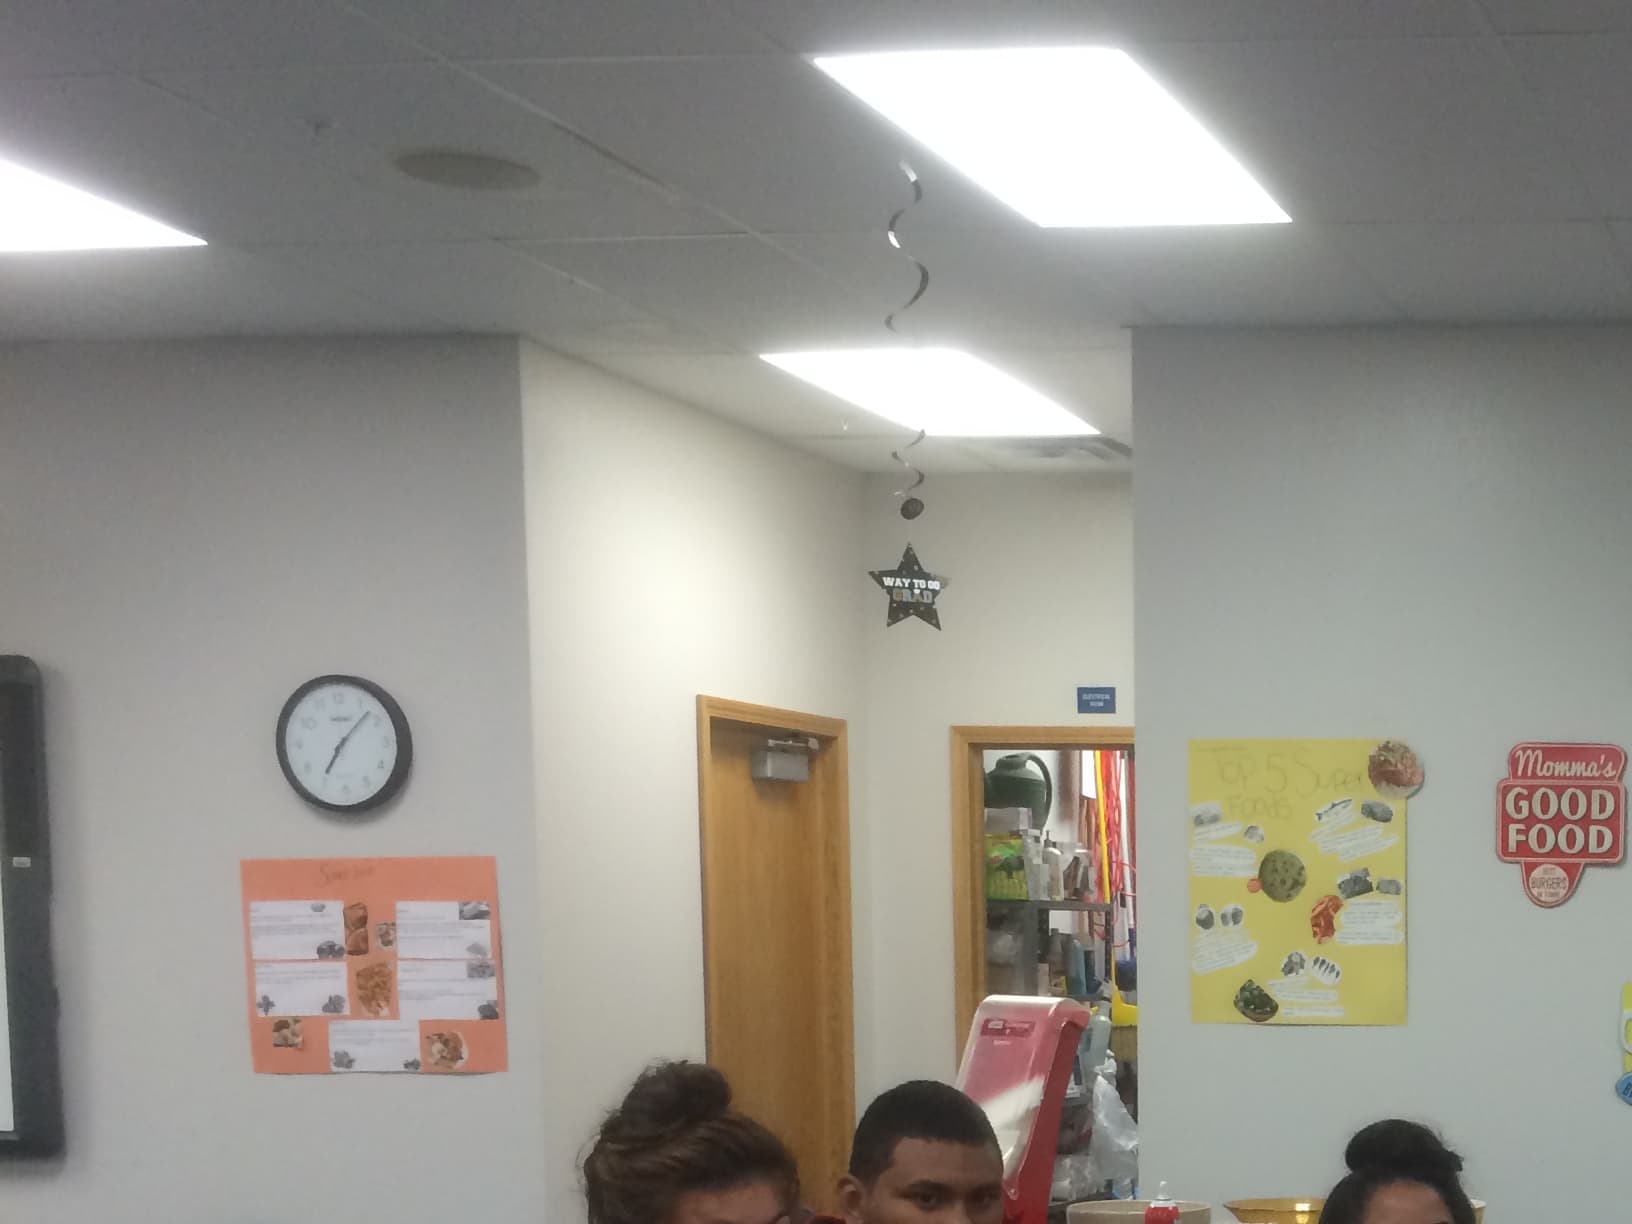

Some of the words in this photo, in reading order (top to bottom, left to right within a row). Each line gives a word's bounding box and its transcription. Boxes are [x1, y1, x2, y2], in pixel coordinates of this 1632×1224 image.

[882, 577, 911, 588] WAY
[912, 578, 926, 589] TO
[1515, 749, 1617, 778] Momma's
[1505, 787, 1615, 821] GOOD
[1508, 823, 1613, 854] FOOD
